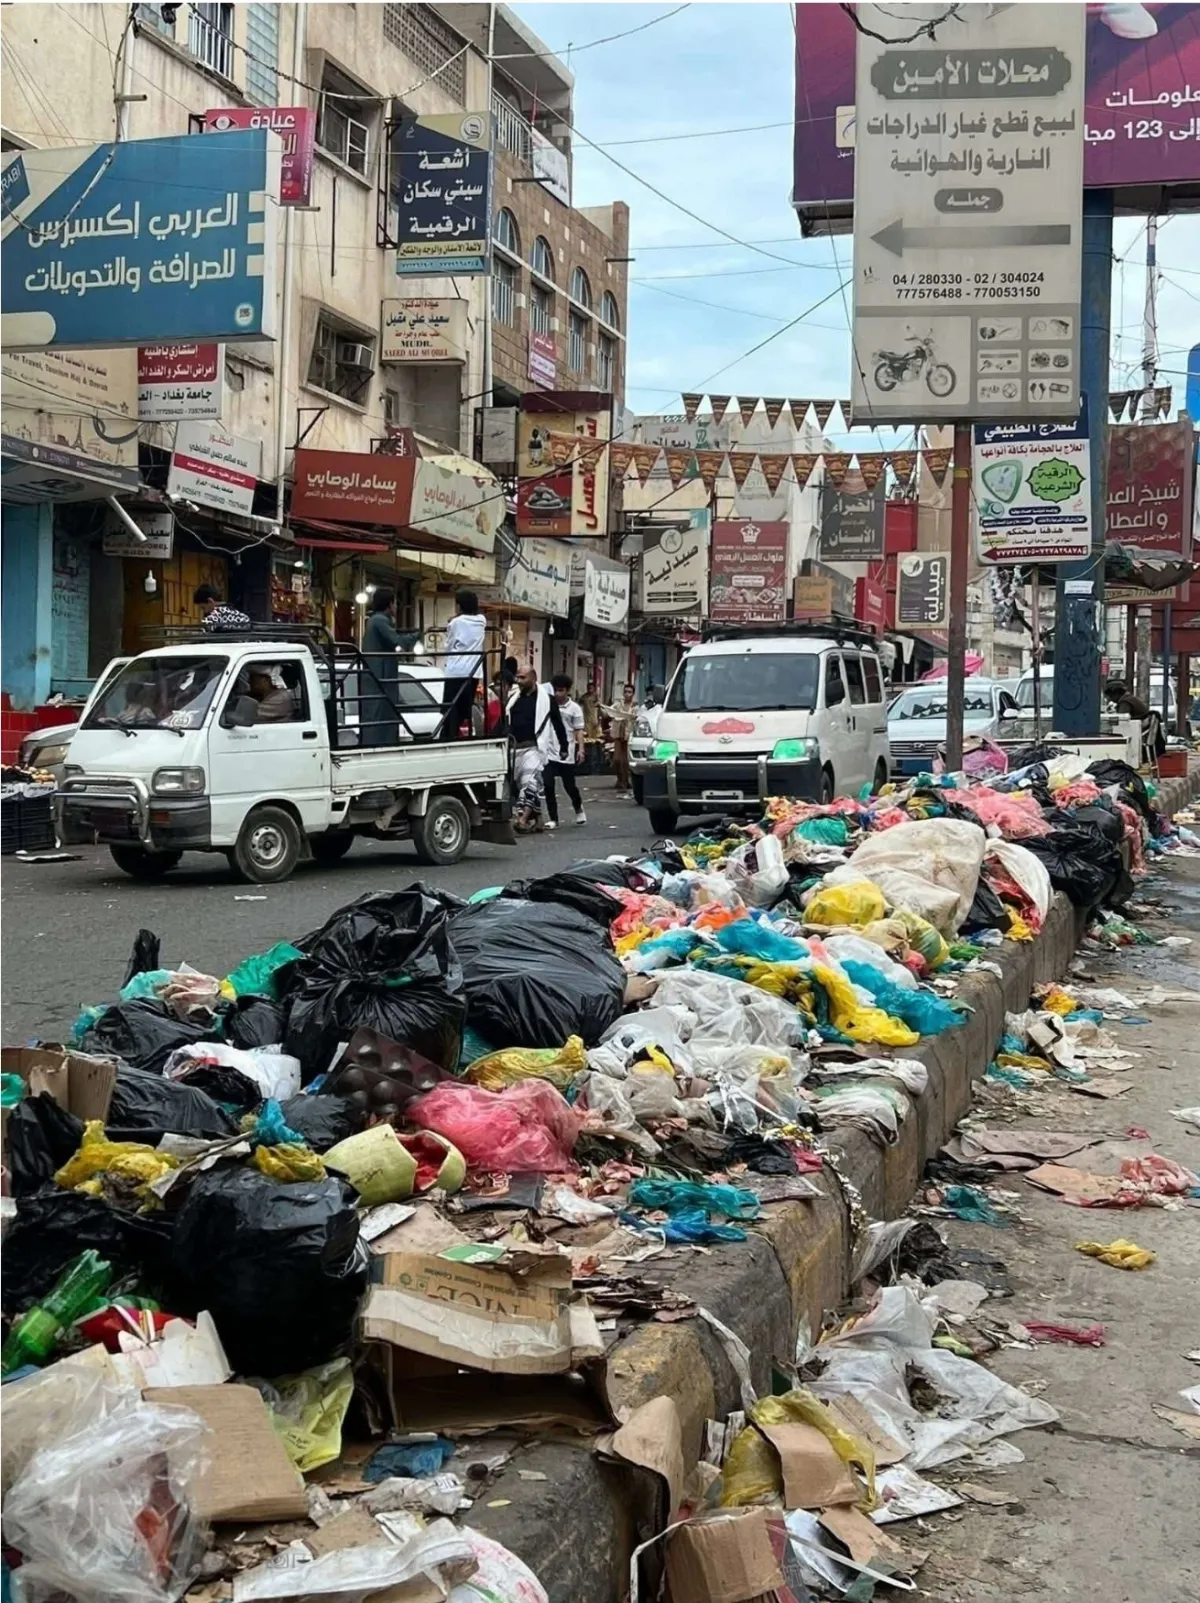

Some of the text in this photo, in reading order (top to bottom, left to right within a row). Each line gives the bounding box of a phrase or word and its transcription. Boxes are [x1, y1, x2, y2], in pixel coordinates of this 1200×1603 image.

[893, 54, 1049, 93] محلات الأمين
[250, 110, 295, 133] عيادة
[867, 109, 1075, 139] لبيع قطع غيار الدراجات
[1124, 120, 1163, 139] 123
[419, 147, 469, 170] أشعة
[891, 147, 1050, 177] النارية والهوائية
[403, 179, 483, 205] سيتي سكان
[28, 192, 238, 248] العربي إكسبرس
[410, 216, 475, 237] الرقمية
[25, 248, 235, 296] للصرافة والتحويلات
[893, 274, 907, 285] 04
[911, 274, 915, 285] /
[918, 274, 962, 285] 280330
[974, 273, 989, 284] 02
[992, 273, 996, 284] /
[1000, 272, 1044, 283] 304024
[896, 288, 962, 299] 777576488
[974, 287, 1040, 298] 770053150
[409, 312, 425, 330] علي
[429, 312, 451, 327] سعيد
[172, 364, 192, 378] السكر
[162, 388, 184, 404] بغداد
[186, 387, 212, 402] جامعة
[307, 470, 397, 495] بسام الوصابي
[1038, 467, 1071, 478] الرقية
[1035, 481, 1076, 492] الشرعية
[1138, 478, 1180, 507] شيخ
[829, 526, 875, 547] الأسنان
[645, 545, 699, 585] صيدلية
[924, 560, 944, 621] صيدلية
